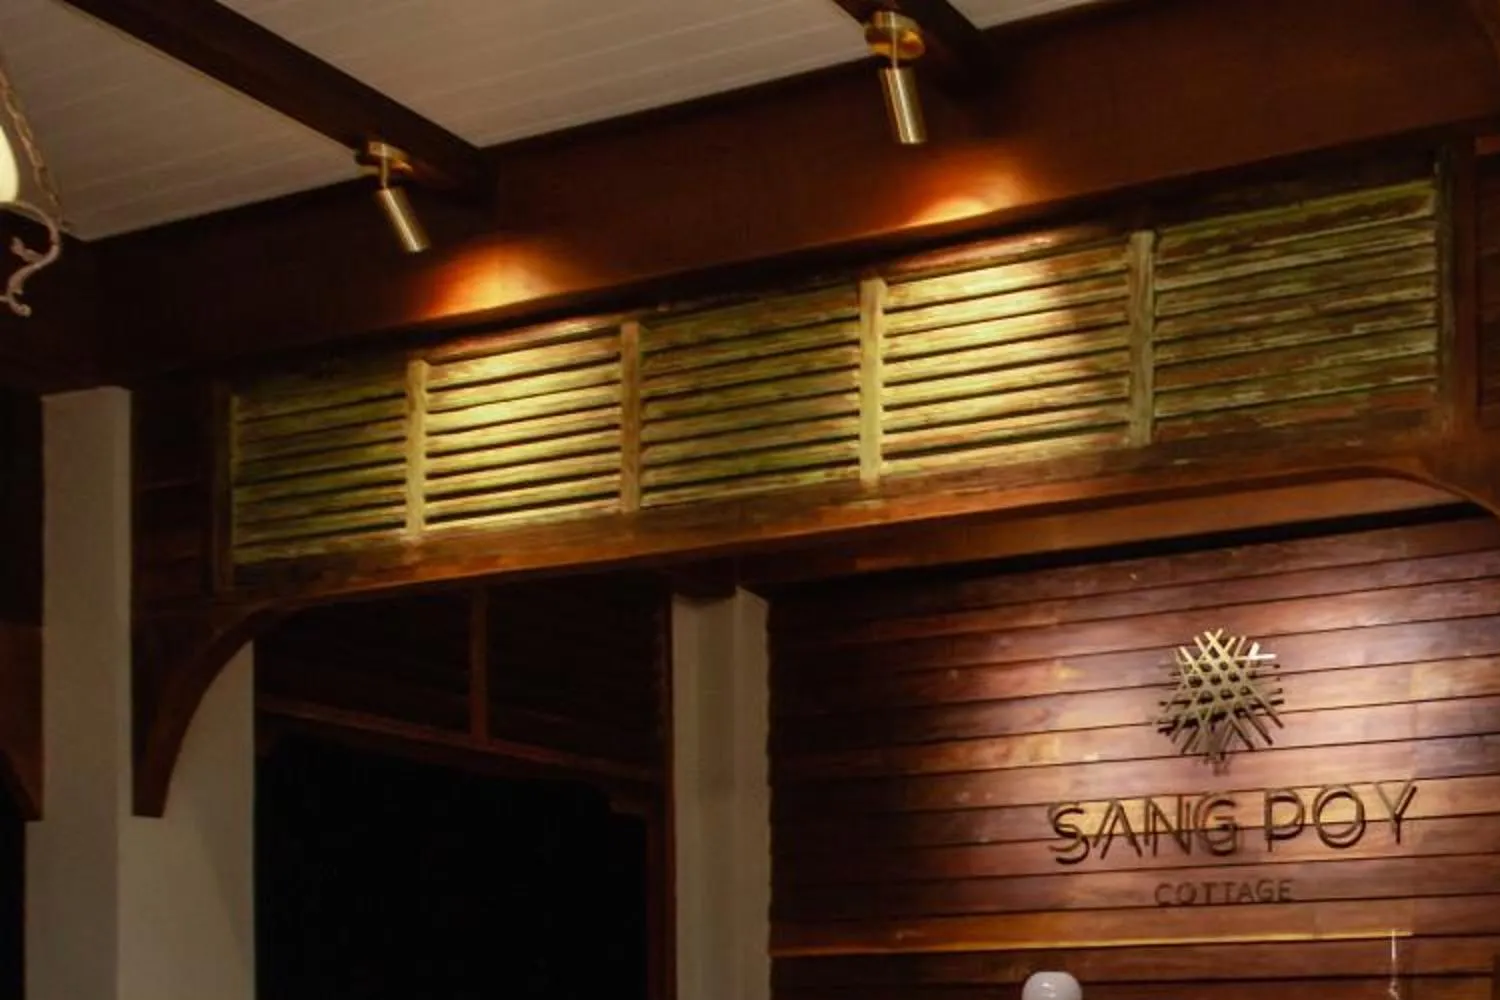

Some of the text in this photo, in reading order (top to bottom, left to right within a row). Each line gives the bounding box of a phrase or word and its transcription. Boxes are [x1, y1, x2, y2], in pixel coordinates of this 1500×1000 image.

[1048, 784, 1417, 864] SANG POY
[1154, 878, 1294, 906] COTTAGE
